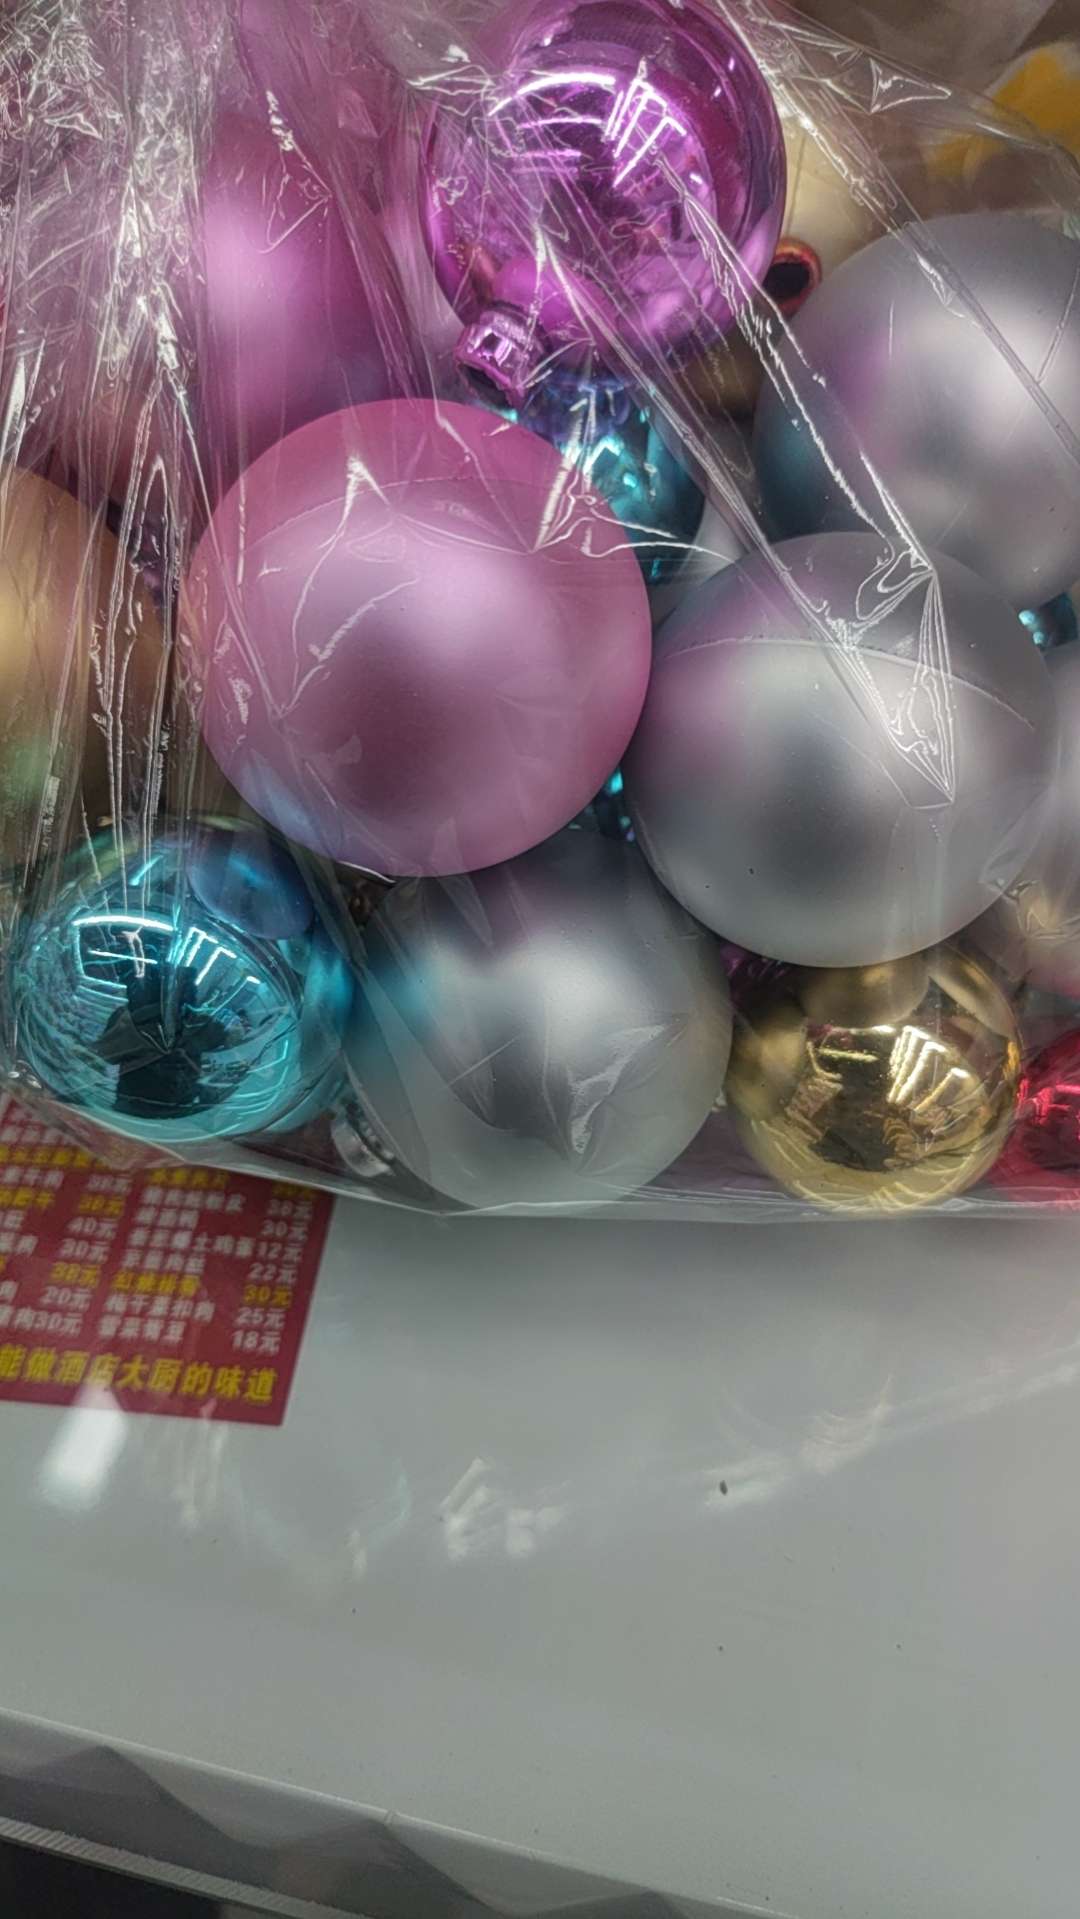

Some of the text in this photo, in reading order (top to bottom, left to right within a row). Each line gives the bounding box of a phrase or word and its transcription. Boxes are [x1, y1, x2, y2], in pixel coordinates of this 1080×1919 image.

[67, 1217, 118, 1239] 40元
[260, 1220, 308, 1243] 30元
[249, 1262, 297, 1285] 22元
[41, 1286, 92, 1310] 20元
[244, 1284, 292, 1308] 30元
[236, 1307, 286, 1330] 25元
[231, 1329, 281, 1355] 18元
